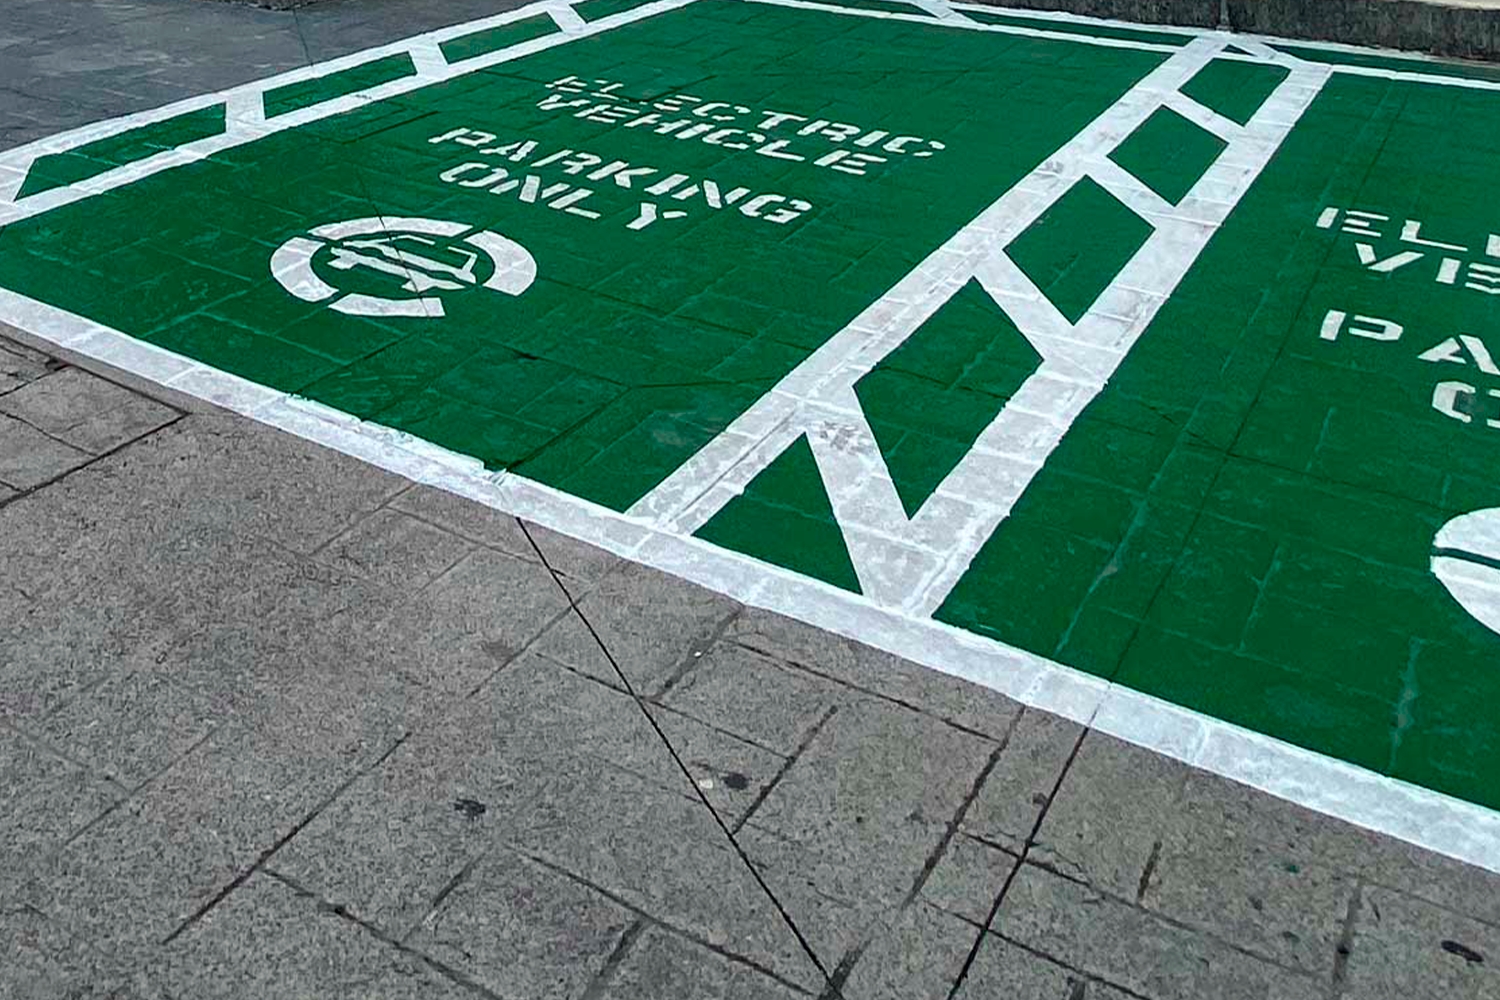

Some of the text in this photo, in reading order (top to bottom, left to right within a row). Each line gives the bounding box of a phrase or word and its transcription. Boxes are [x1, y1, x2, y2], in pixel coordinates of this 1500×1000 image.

[536, 94, 889, 175] VEHICLE
[545, 75, 947, 158] ELECTRIC
[428, 127, 813, 225] PARKING
[438, 162, 688, 230] ONLY
[1315, 206, 1500, 258] EL
